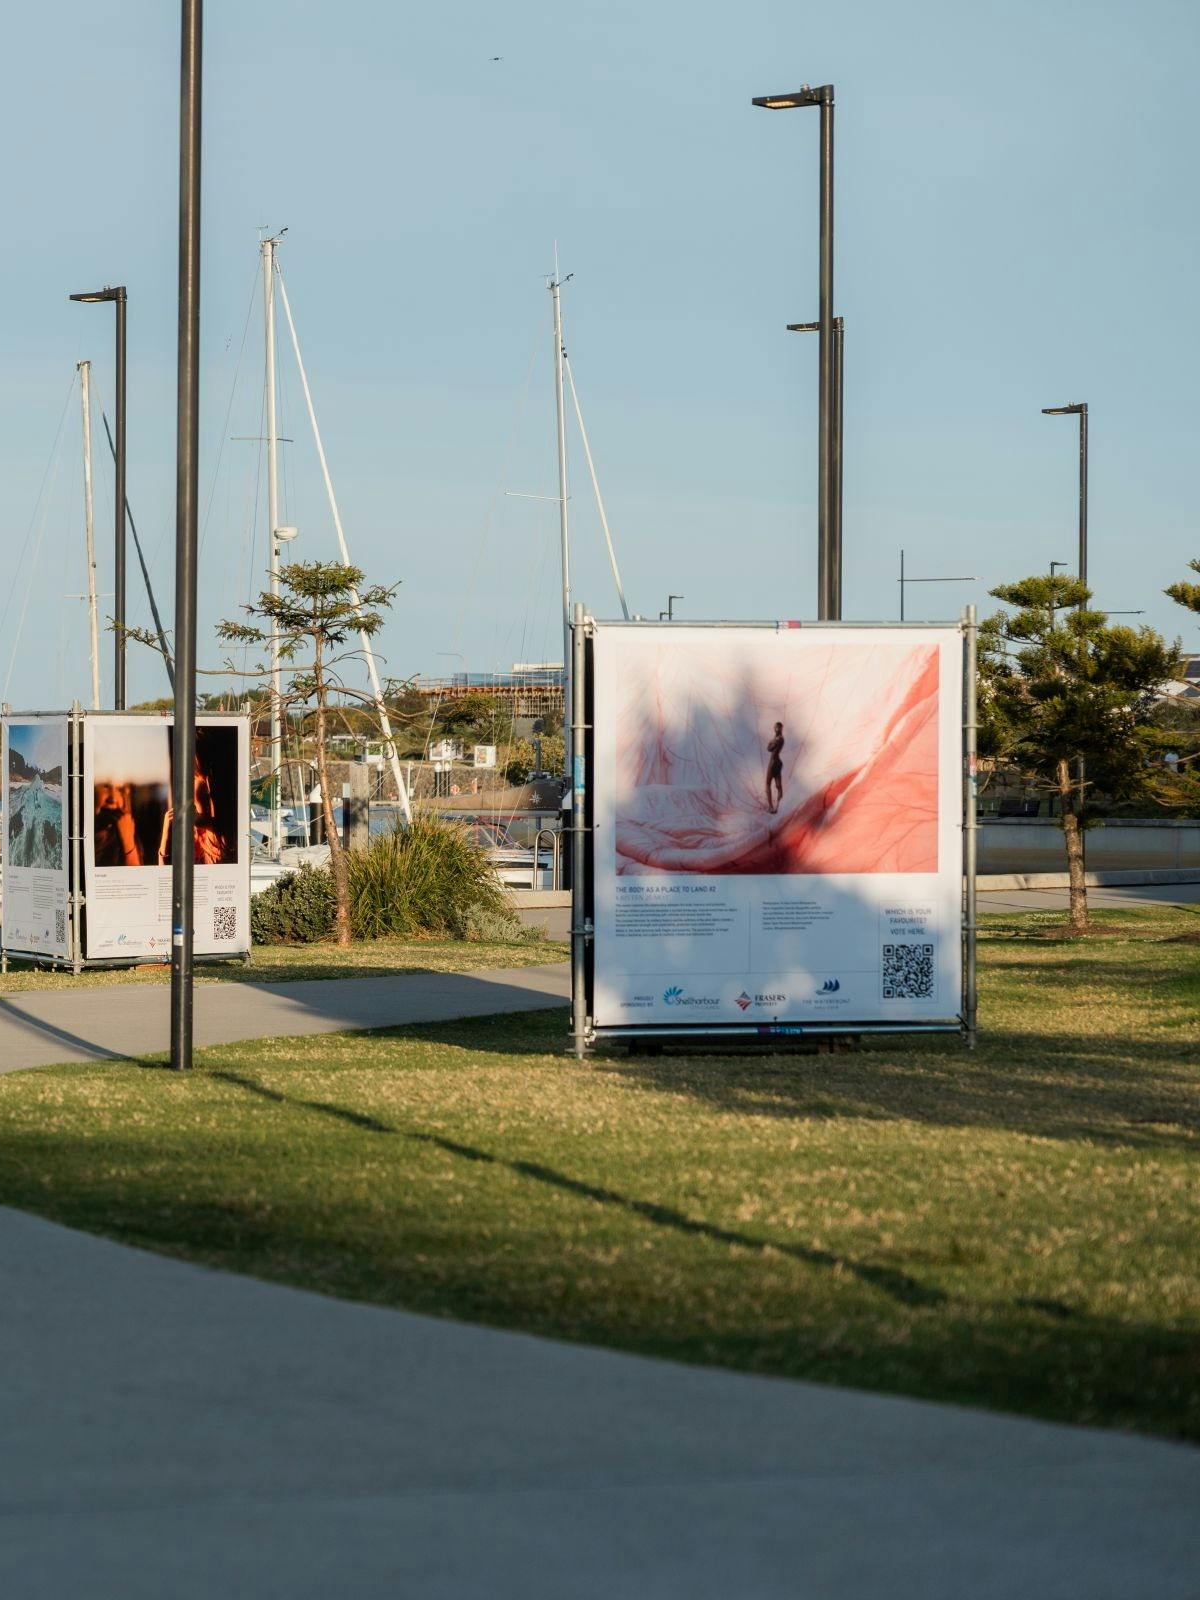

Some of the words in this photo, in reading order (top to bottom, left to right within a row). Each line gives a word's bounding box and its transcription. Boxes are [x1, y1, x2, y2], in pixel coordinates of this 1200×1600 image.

[615, 886, 627, 894] THE
[690, 885, 708, 893] LAND
[675, 996, 720, 1006] Shellharbour
[754, 994, 787, 1002] FRASERS
